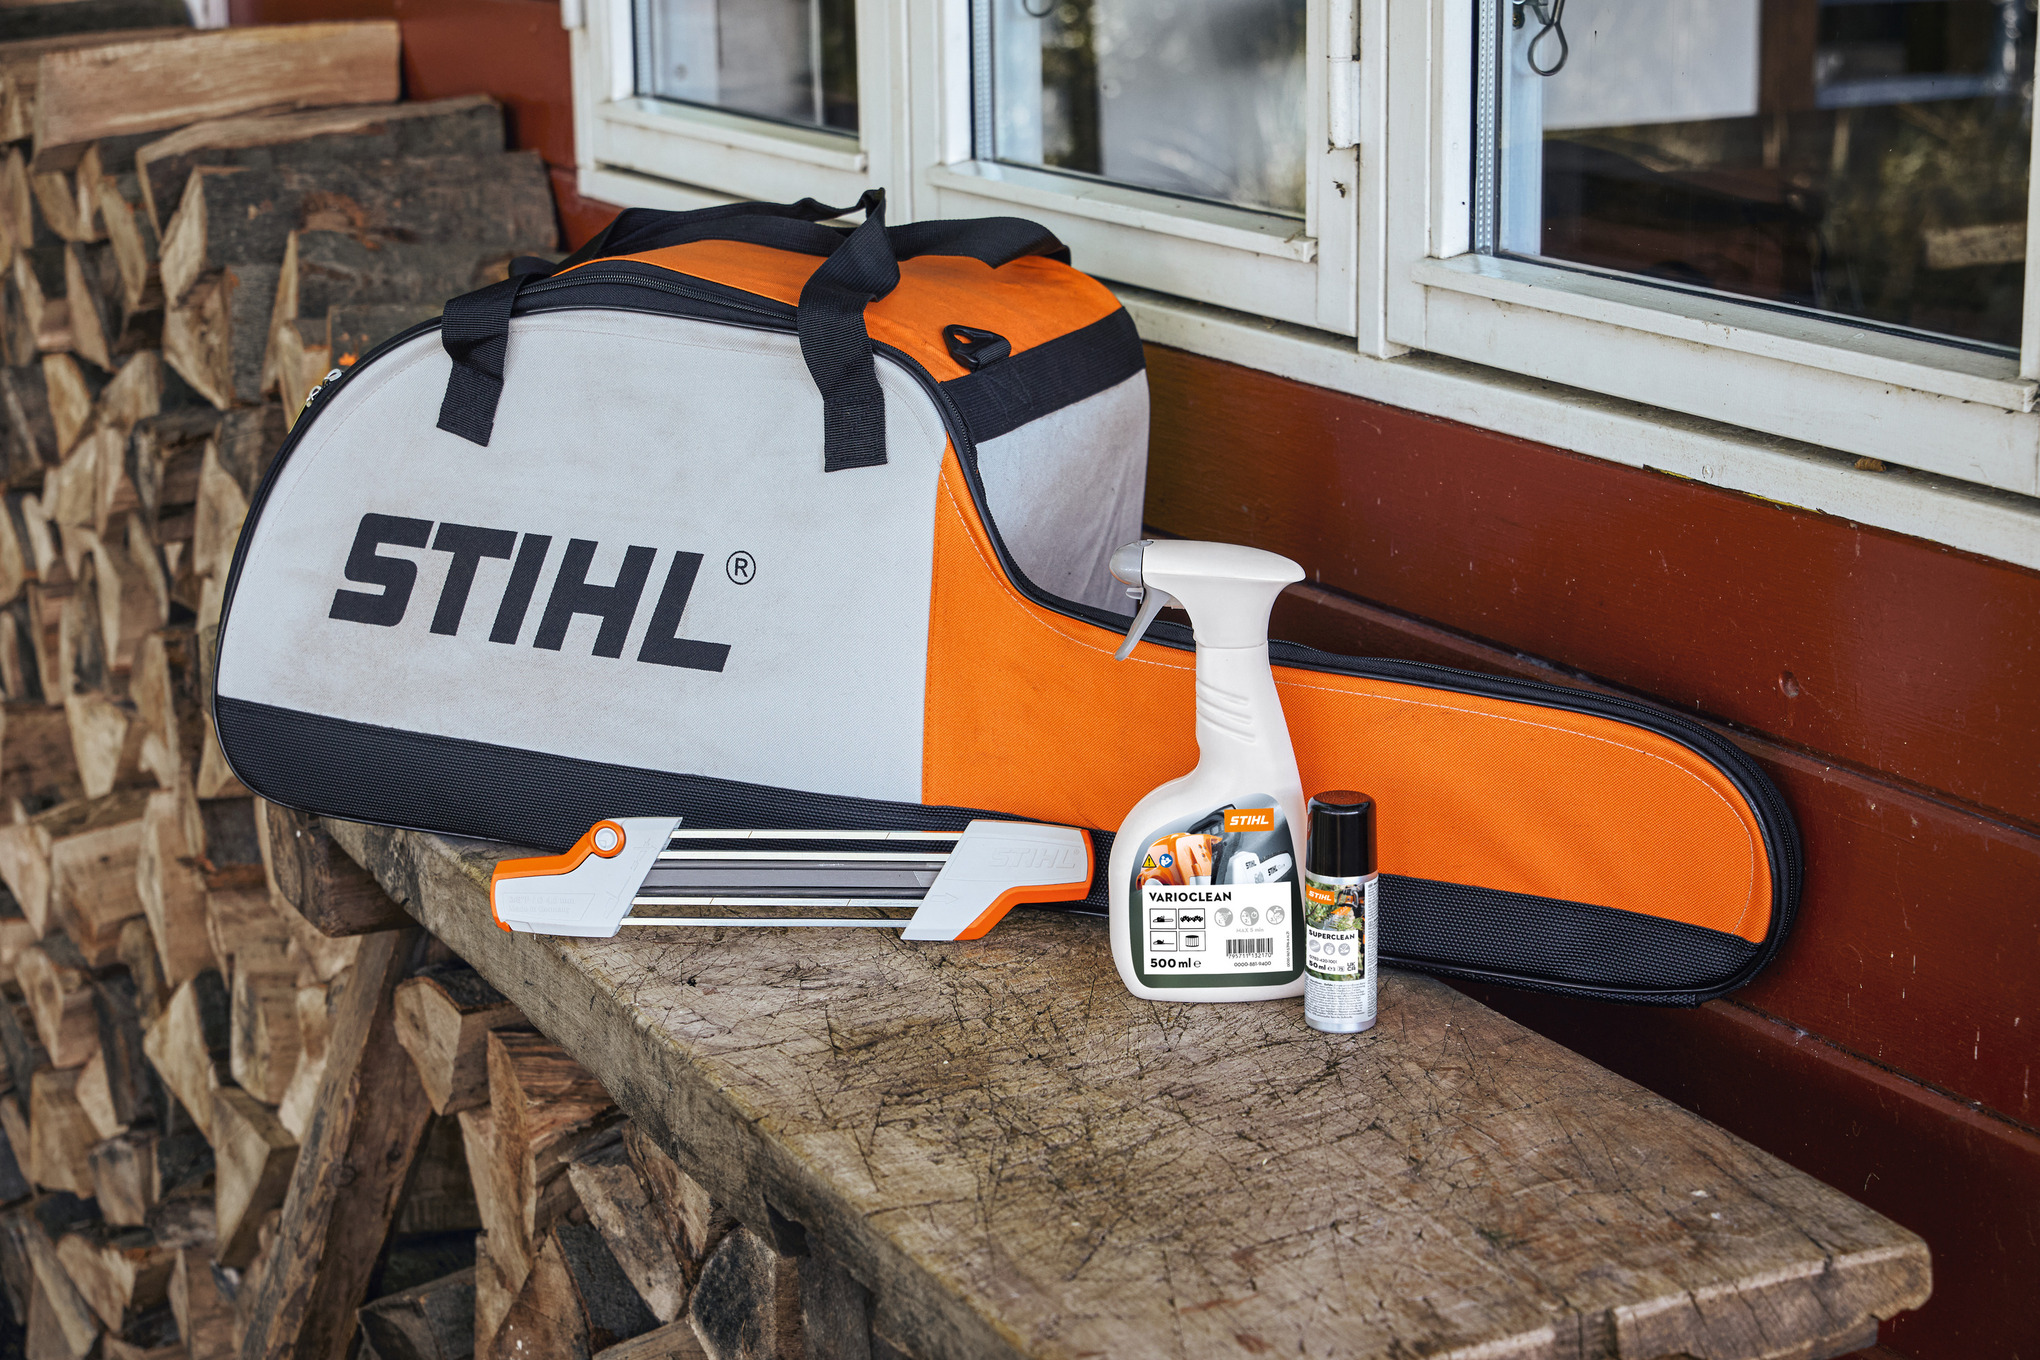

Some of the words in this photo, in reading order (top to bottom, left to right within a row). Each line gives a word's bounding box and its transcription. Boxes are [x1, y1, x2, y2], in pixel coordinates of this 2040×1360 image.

[1229, 814, 1270, 826] STIHL
[1245, 860, 1257, 870] STIHL
[1267, 865, 1278, 876] STIHL
[1148, 891, 1232, 902] VARIOCLEAN
[1308, 890, 1332, 902] STIHL
[1308, 929, 1355, 941] SUPERCLEAN
[1150, 958, 1176, 968] 500
[1178, 957, 1191, 968] ml
[1308, 960, 1318, 968] 50
